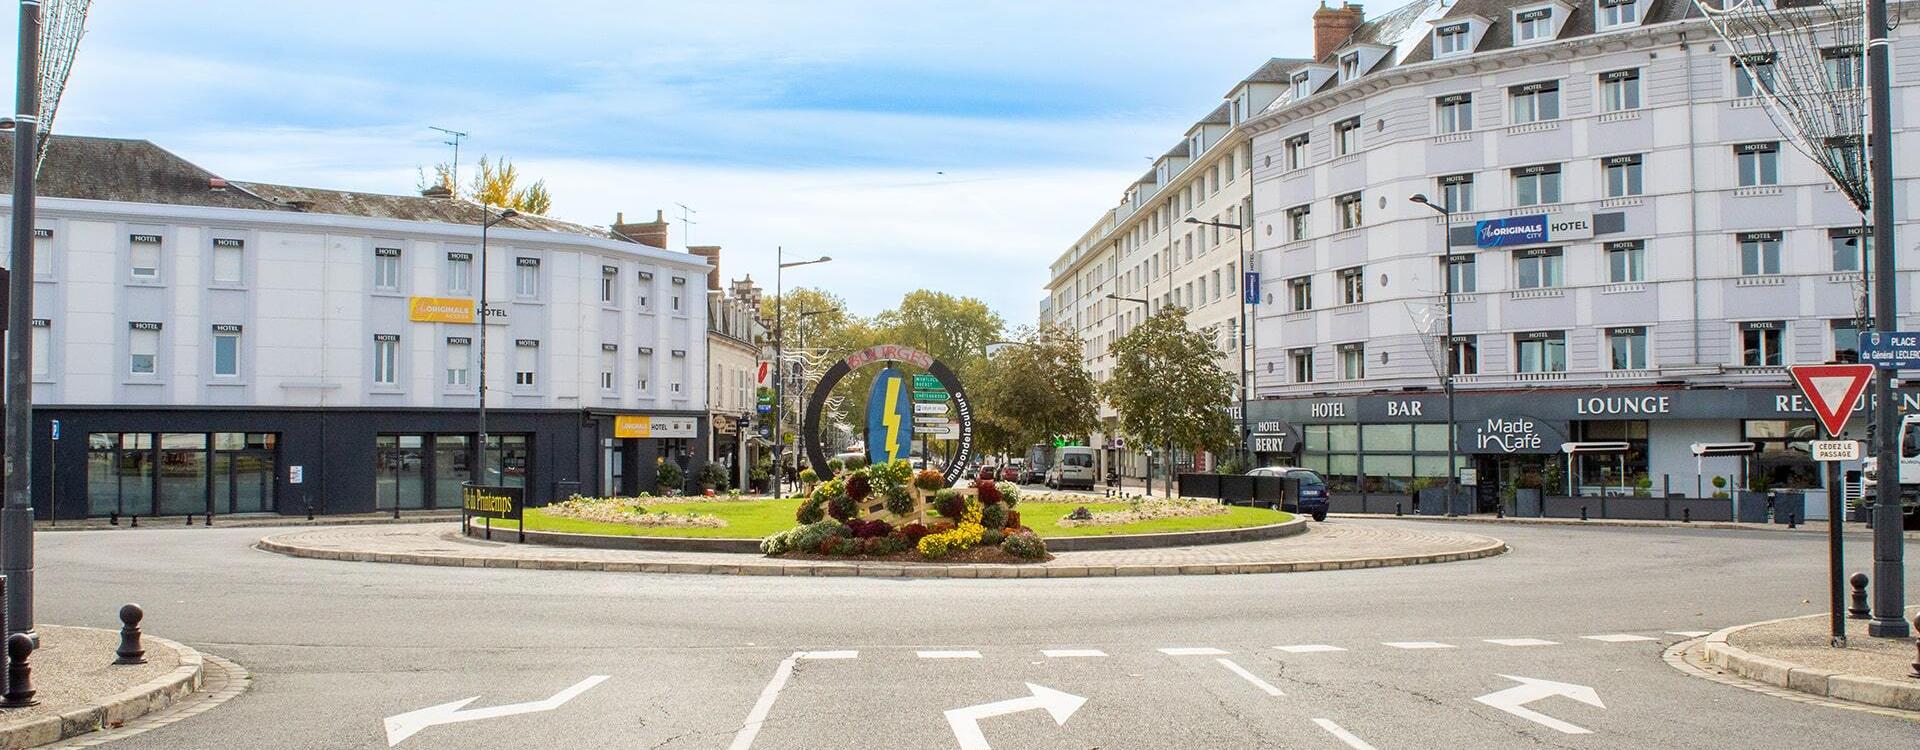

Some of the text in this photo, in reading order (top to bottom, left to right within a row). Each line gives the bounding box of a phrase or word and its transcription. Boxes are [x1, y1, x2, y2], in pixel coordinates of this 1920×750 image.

[1524, 10, 1543, 19] HOTEL
[1443, 24, 1461, 32] HOTEL
[1608, 71, 1629, 79] HOTEL
[1523, 83, 1542, 91] HOTEL
[1493, 224, 1543, 236] ORIGINALS
[1551, 220, 1589, 232] HOTEL
[1891, 337, 1917, 347] PLACE
[848, 346, 931, 367] BOURGES
[1862, 350, 1870, 360] du
[1311, 403, 1345, 418] HOTEL
[1387, 400, 1423, 416] BAR
[1577, 396, 1670, 415] LOUNGE
[1258, 421, 1281, 432] HOTEL
[1487, 418, 1534, 433] Made
[947, 392, 972, 483] maisondelaculture
[1504, 433, 1541, 449] Café
[1255, 438, 1284, 452] BERRY
[476, 488, 512, 519] Printemps
